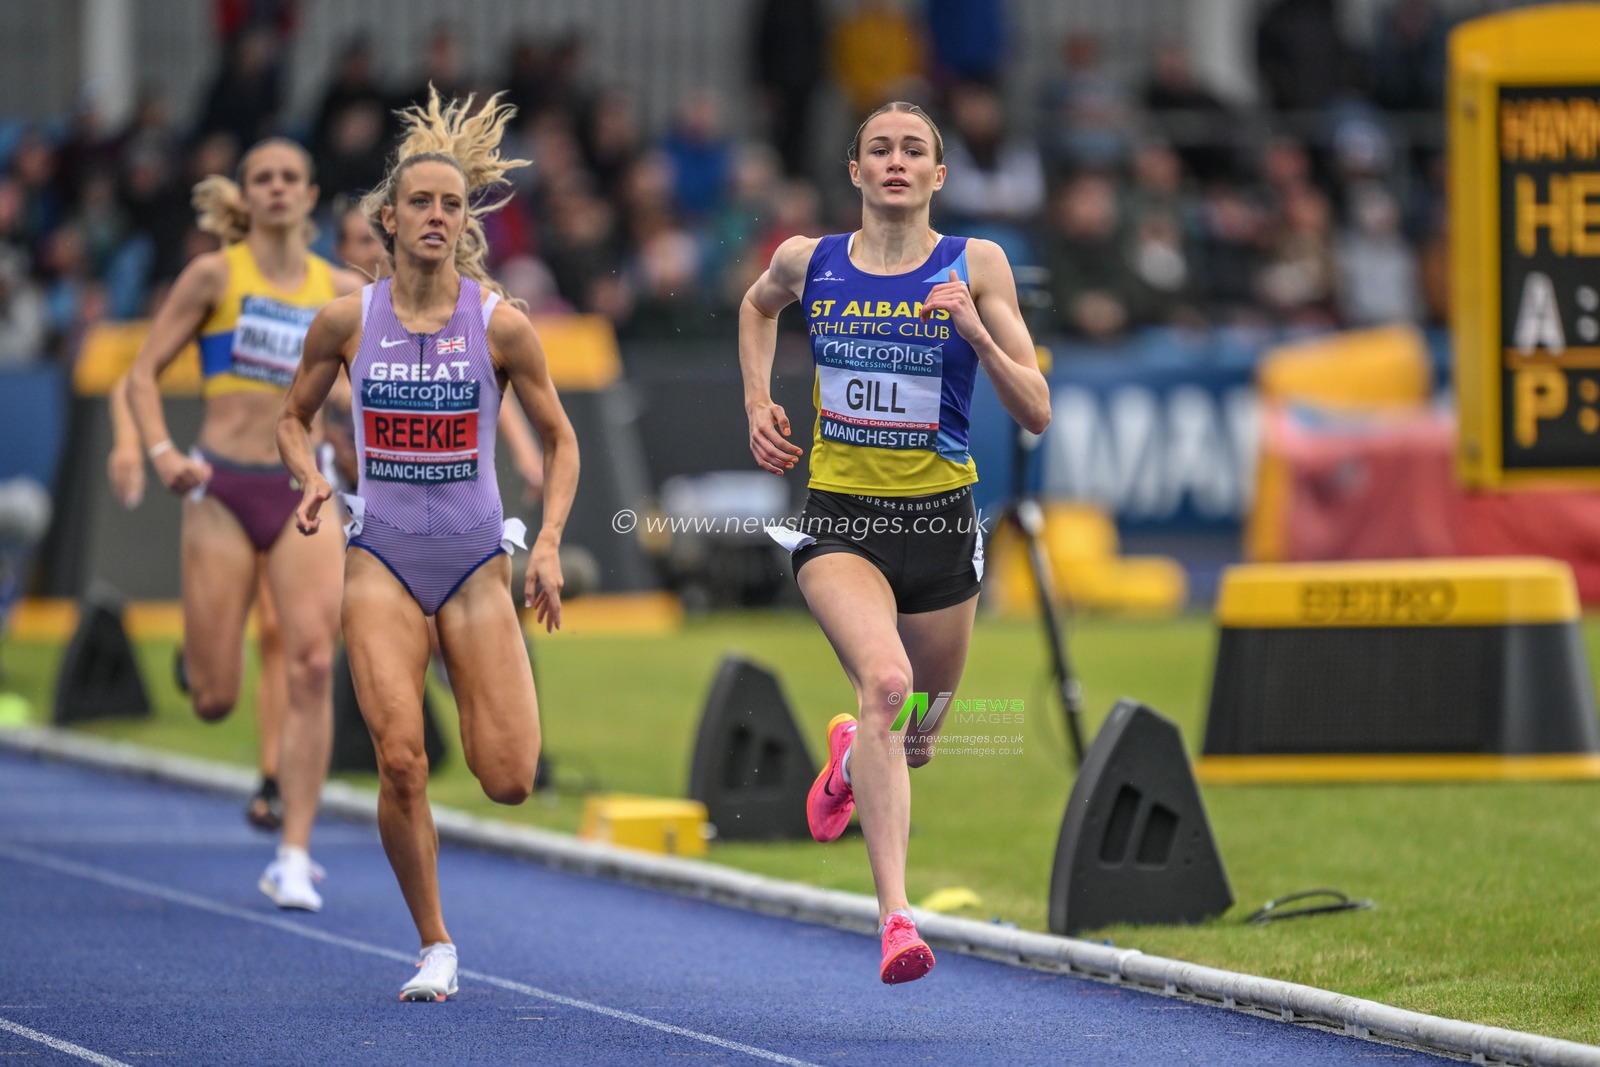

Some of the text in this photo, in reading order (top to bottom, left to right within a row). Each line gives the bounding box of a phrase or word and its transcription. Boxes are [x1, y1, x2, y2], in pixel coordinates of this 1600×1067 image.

[810, 300, 836, 318] ST
[809, 322, 950, 340] ATHLETIC CLUB
[369, 361, 470, 381] GREAT
[825, 357, 843, 366] DATA
[844, 359, 892, 369] PROCESSING
[904, 365, 932, 373] TIMING
[389, 400, 435, 408] PROCESSING
[846, 378, 906, 415] GILL
[834, 413, 868, 425] ATHLETICS
[869, 420, 931, 429] CHAMPIONSHIPS
[375, 416, 467, 448] REEKIE
[824, 421, 929, 447] MANCHESTER
[371, 461, 472, 480] MANCHESTER
[899, 498, 948, 511] ARMOUR
